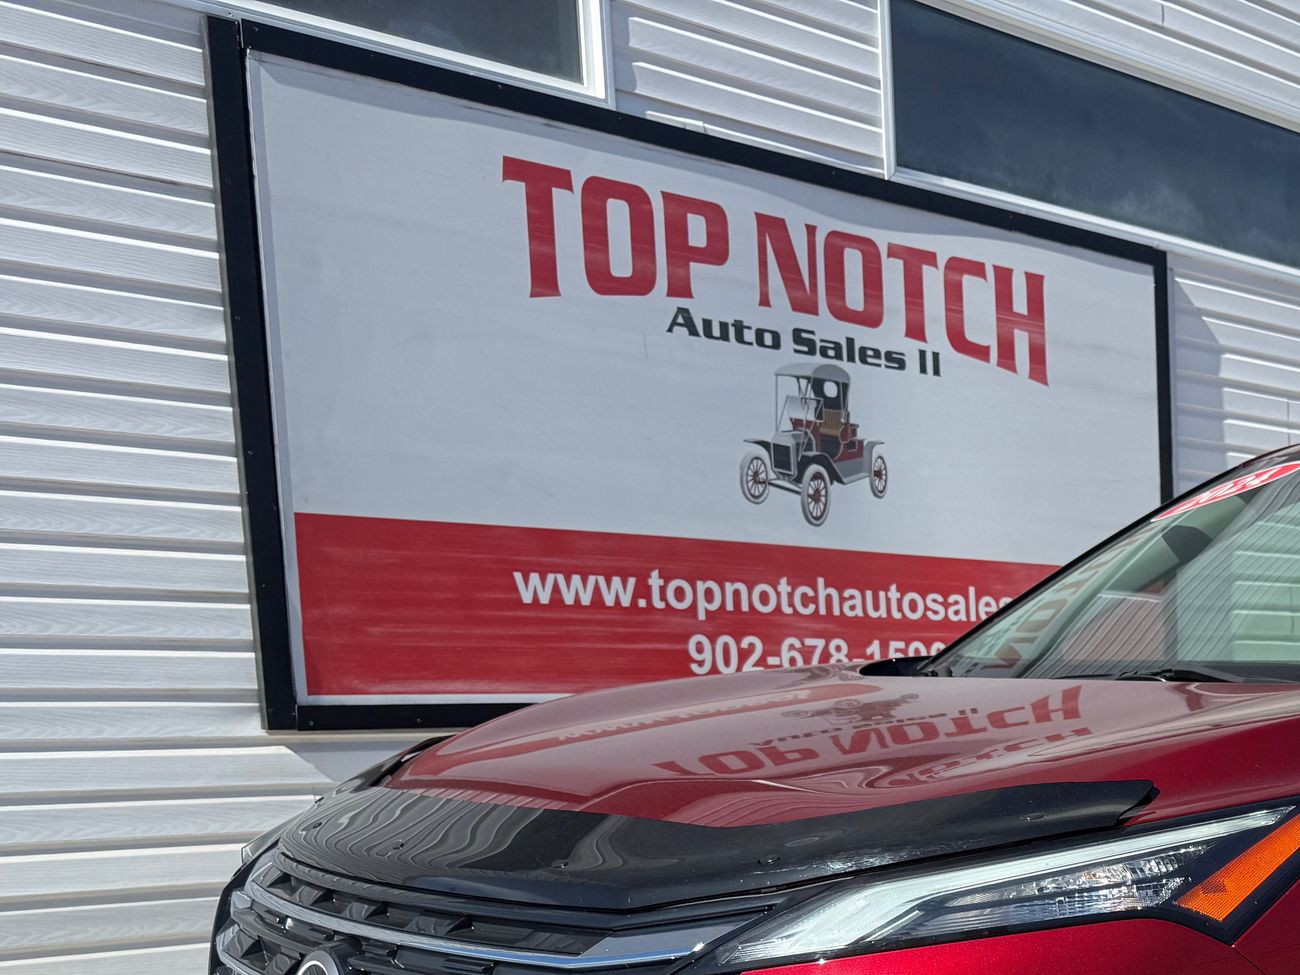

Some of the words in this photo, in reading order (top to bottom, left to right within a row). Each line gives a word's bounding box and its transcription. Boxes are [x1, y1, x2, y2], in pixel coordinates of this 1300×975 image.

[502, 155, 729, 299] TOP
[755, 211, 1049, 387] NOTCH
[666, 305, 781, 351] Auto
[792, 327, 907, 372] Sales
[919, 348, 942, 377] II
